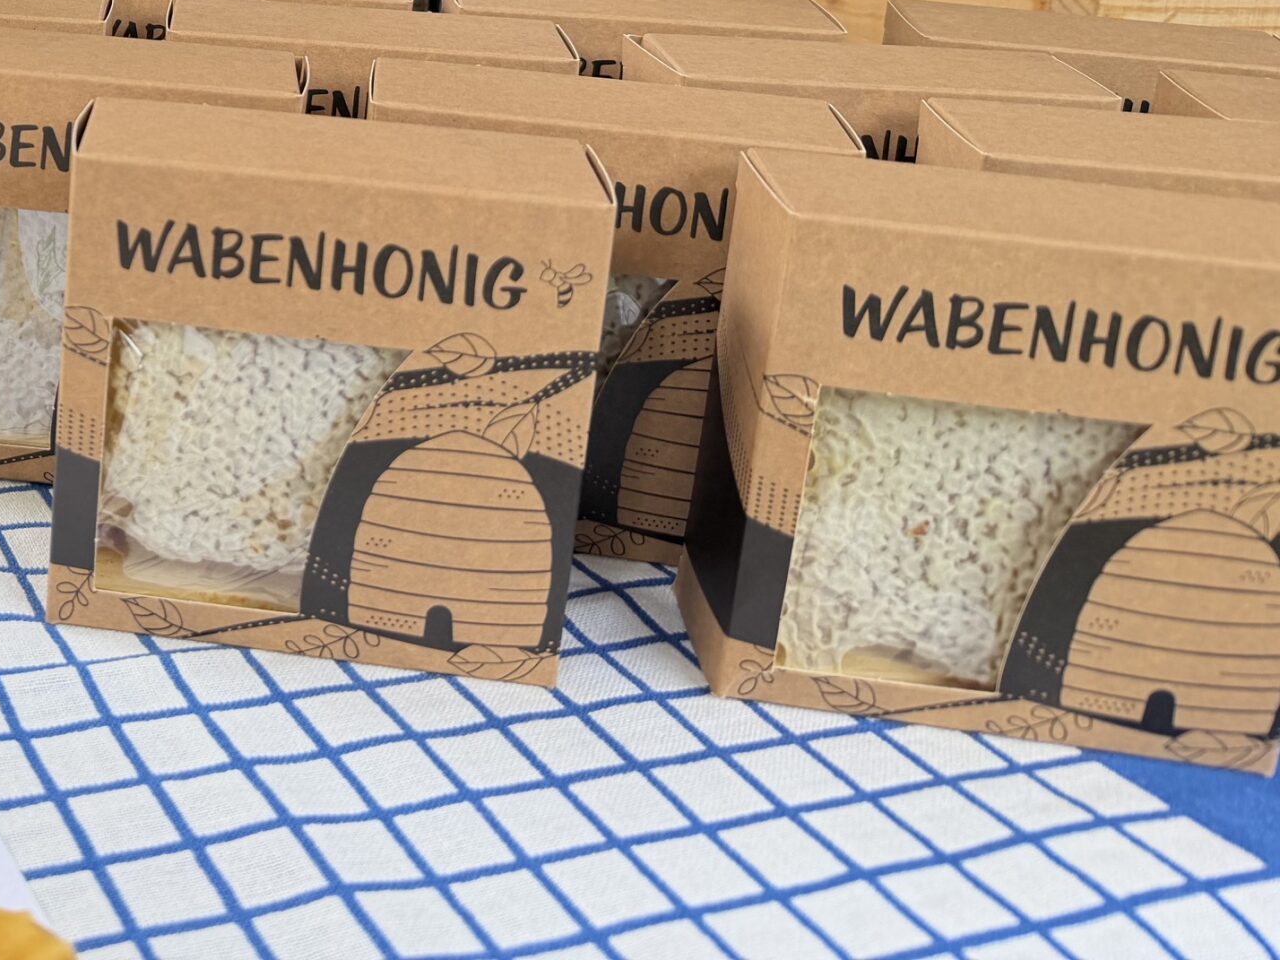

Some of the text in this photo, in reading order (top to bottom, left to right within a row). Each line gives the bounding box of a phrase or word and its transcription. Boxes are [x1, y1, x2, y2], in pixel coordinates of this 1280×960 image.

[615, 181, 730, 243] HON
[115, 219, 528, 311] WABENHONIG
[842, 284, 1280, 386] WABENHONIG
